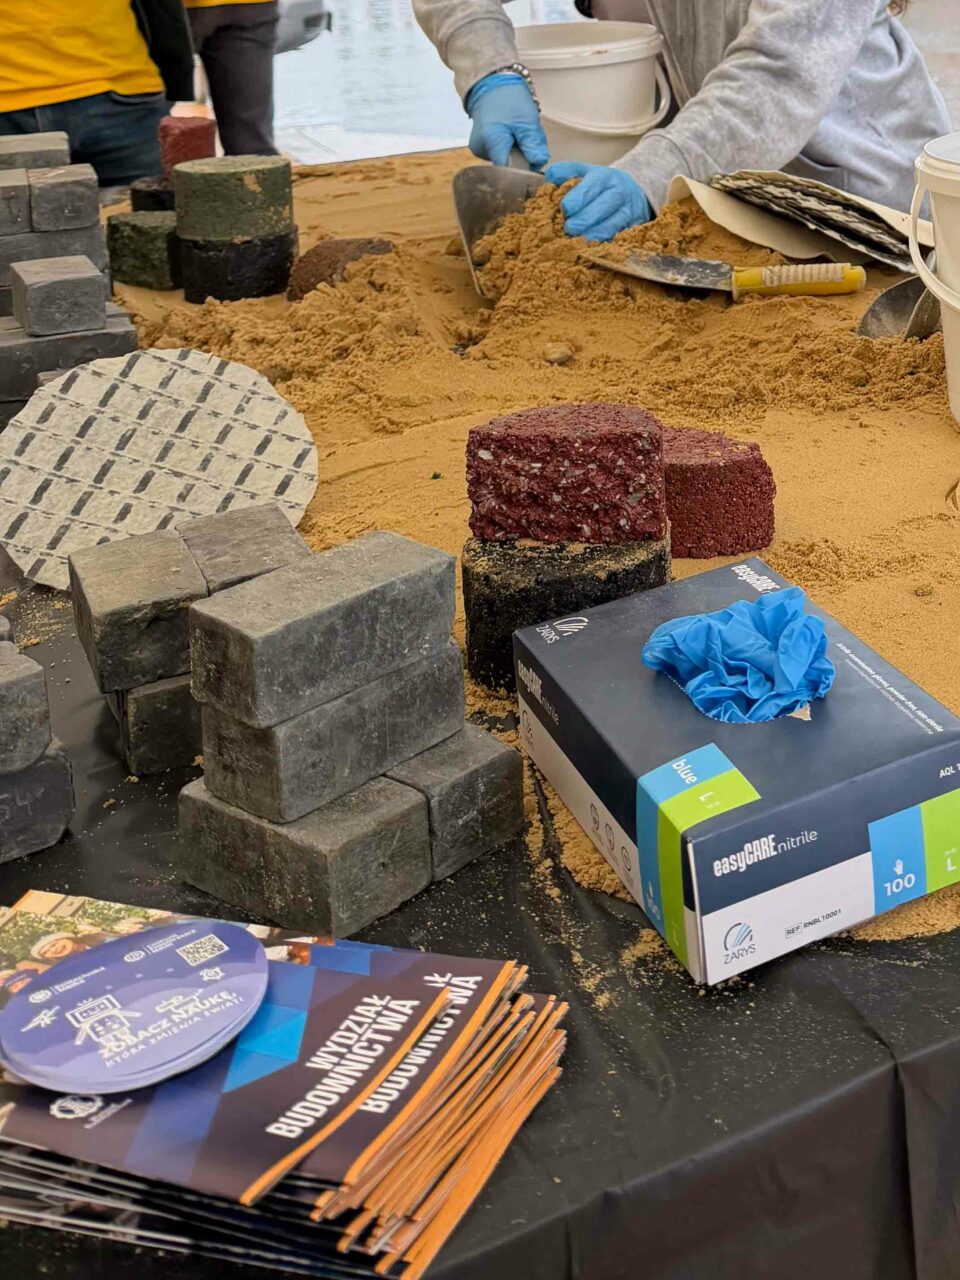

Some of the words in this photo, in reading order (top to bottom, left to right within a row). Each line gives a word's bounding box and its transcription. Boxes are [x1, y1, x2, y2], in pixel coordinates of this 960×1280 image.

[536, 624, 560, 644] ZARYS
[671, 758, 698, 785] blue
[939, 765, 956, 778] AQL
[713, 834, 777, 877] easyCARE
[777, 830, 818, 854] nitrile
[946, 857, 957, 872] L
[884, 873, 916, 897] 100
[786, 925, 801, 937] REF
[723, 943, 757, 965] ZARYS
[305, 993, 392, 1070] WYDZIAŁ
[265, 999, 421, 1139] BUDOWNICTWA
